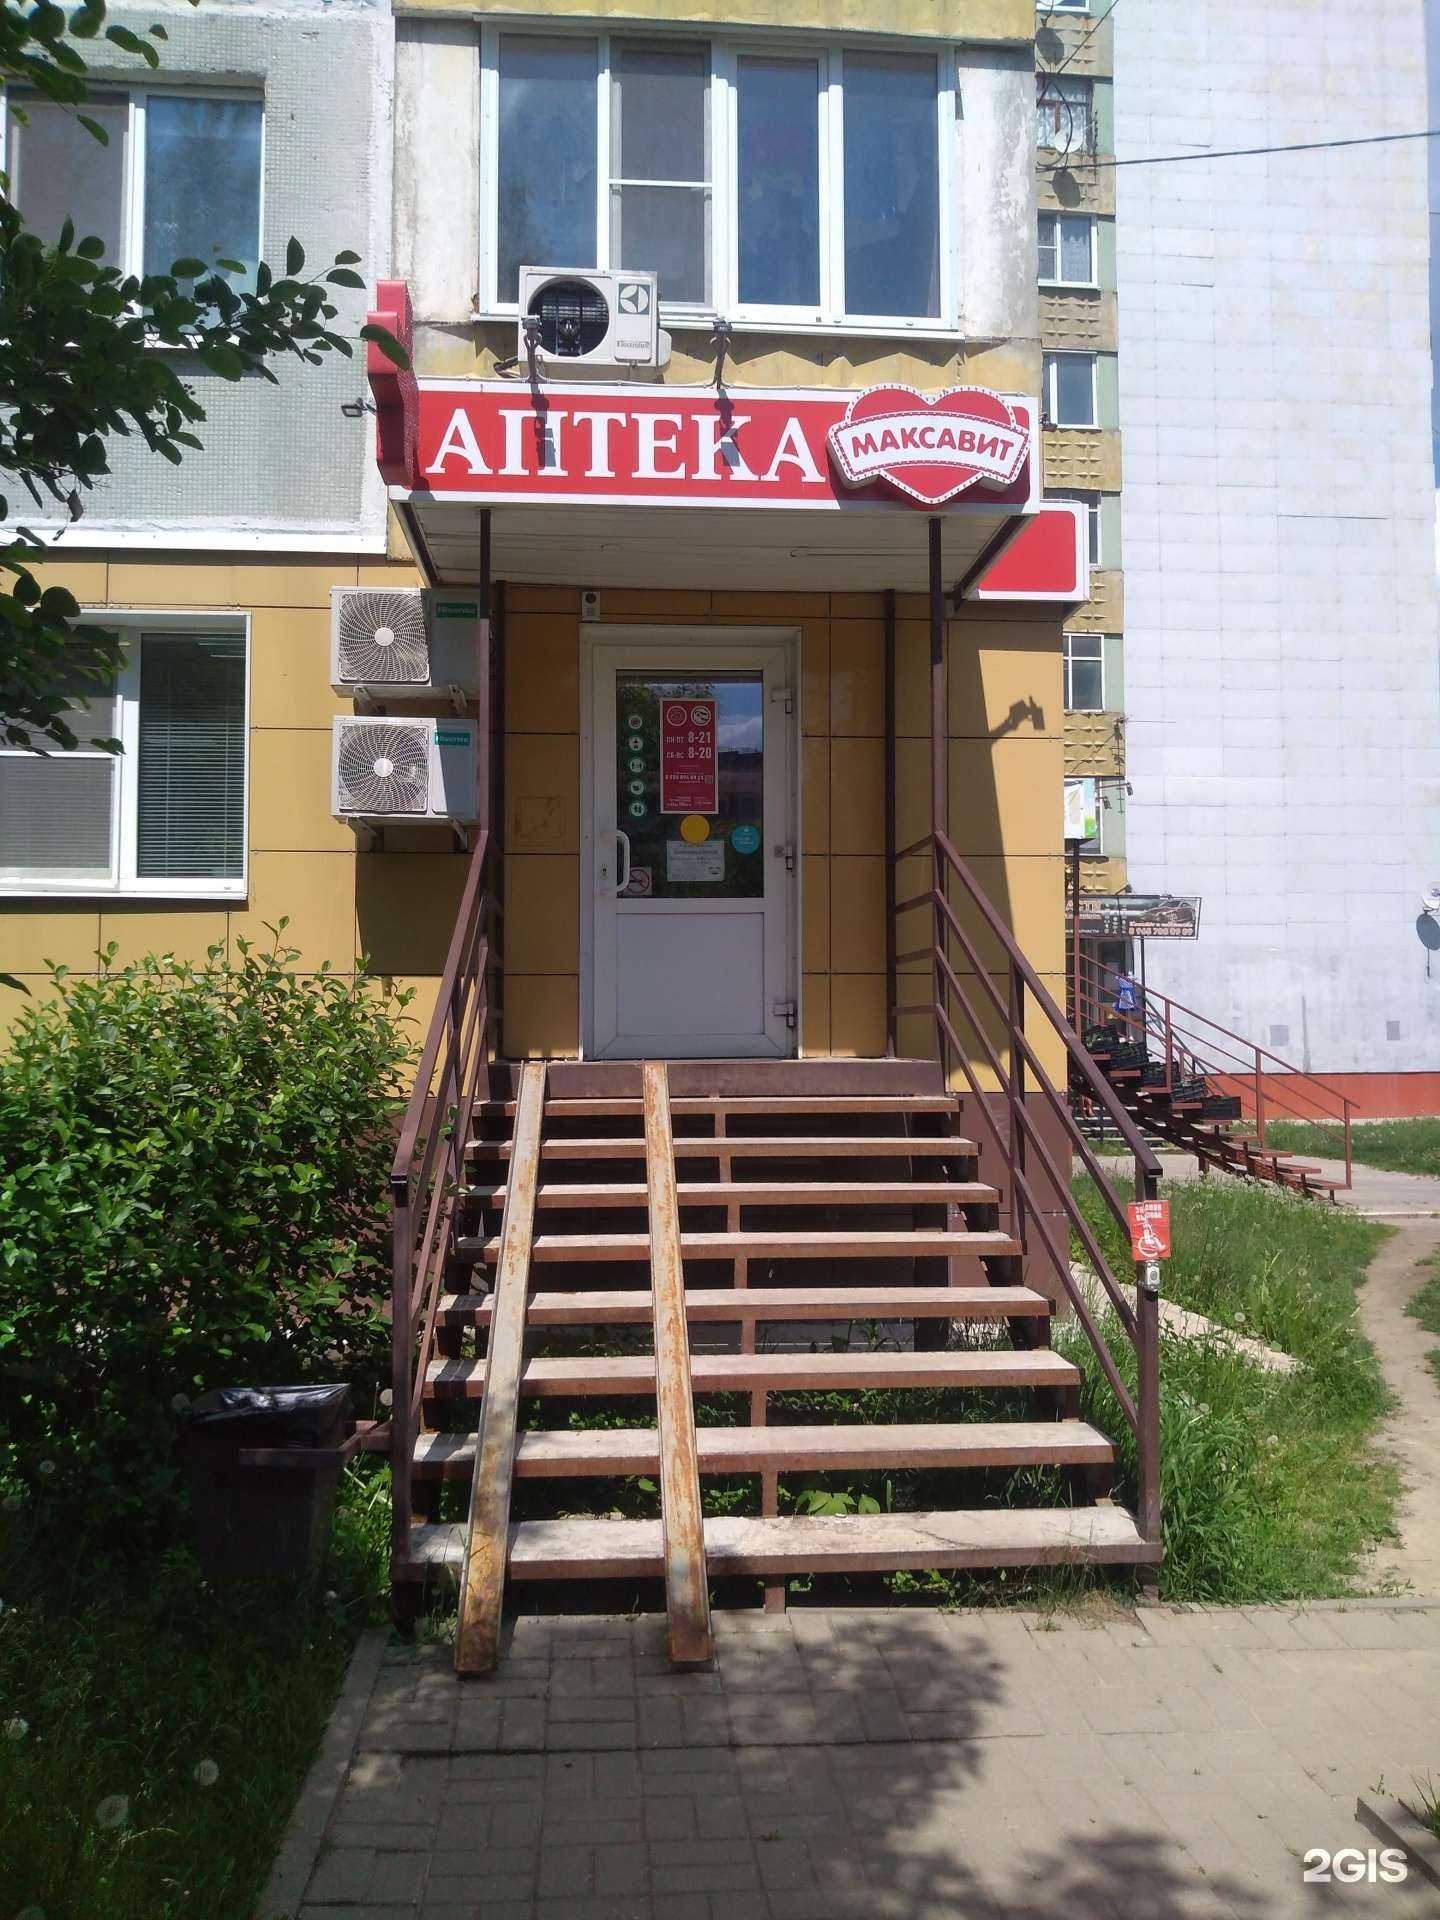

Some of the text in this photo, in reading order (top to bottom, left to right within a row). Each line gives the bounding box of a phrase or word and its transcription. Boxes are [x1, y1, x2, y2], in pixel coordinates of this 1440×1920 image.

[425, 408, 826, 484] АПТЕКА
[851, 424, 1015, 461] МАКСАВИТ
[688, 731, 711, 744] 8-21
[688, 746, 712, 759] 8-20
